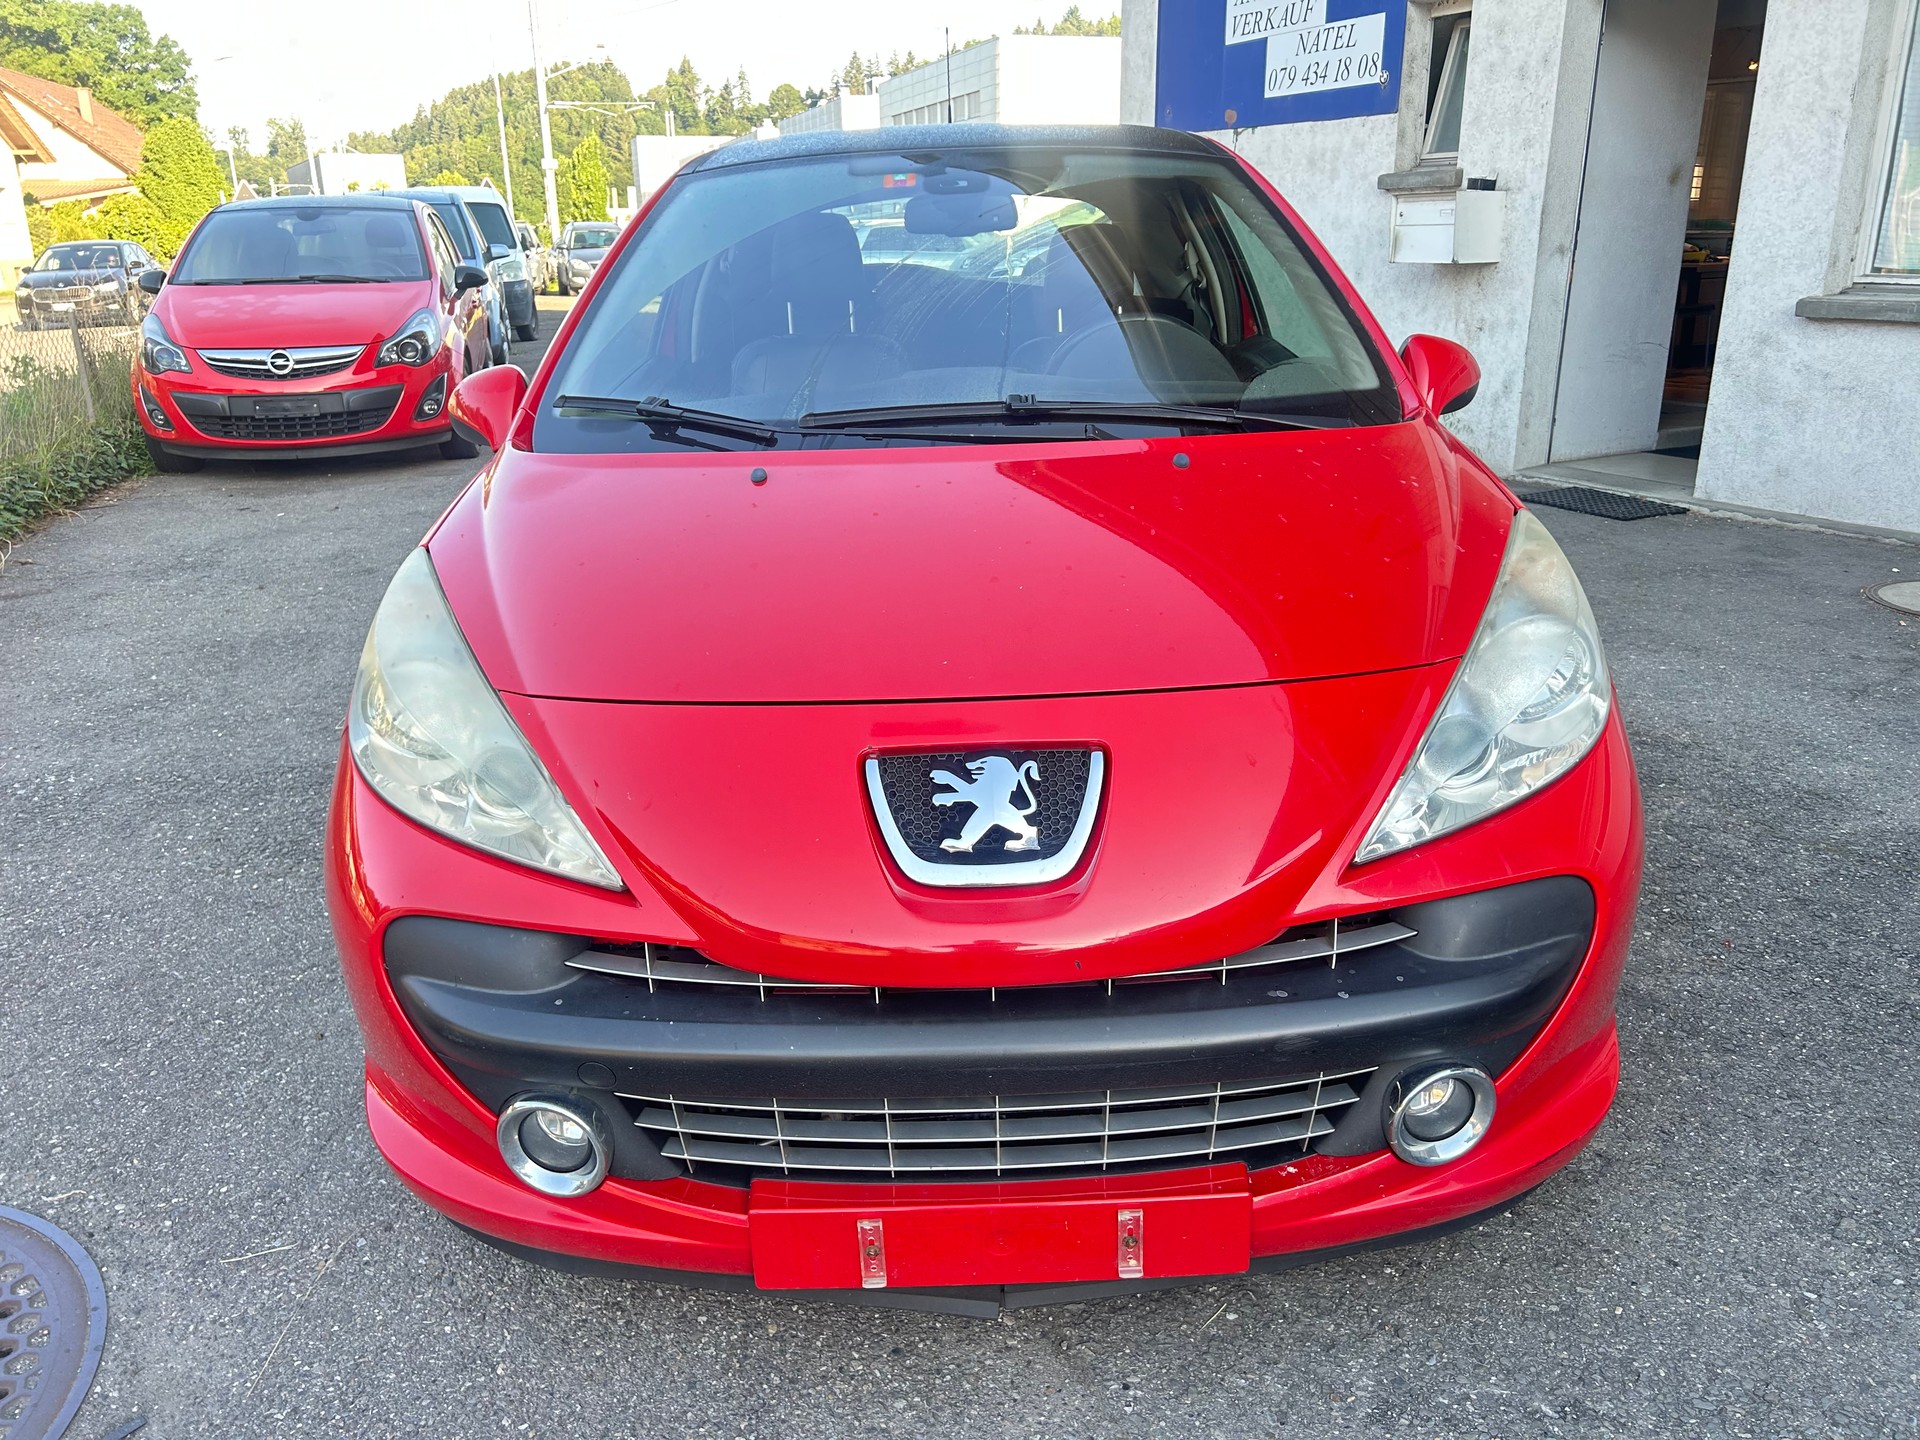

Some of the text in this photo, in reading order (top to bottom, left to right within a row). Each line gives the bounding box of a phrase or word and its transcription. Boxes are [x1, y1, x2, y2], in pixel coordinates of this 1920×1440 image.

[1232, 0, 1317, 38] VERKAUF
[1295, 23, 1357, 56] NATEL
[1268, 52, 1380, 92] 079 434 18 08
